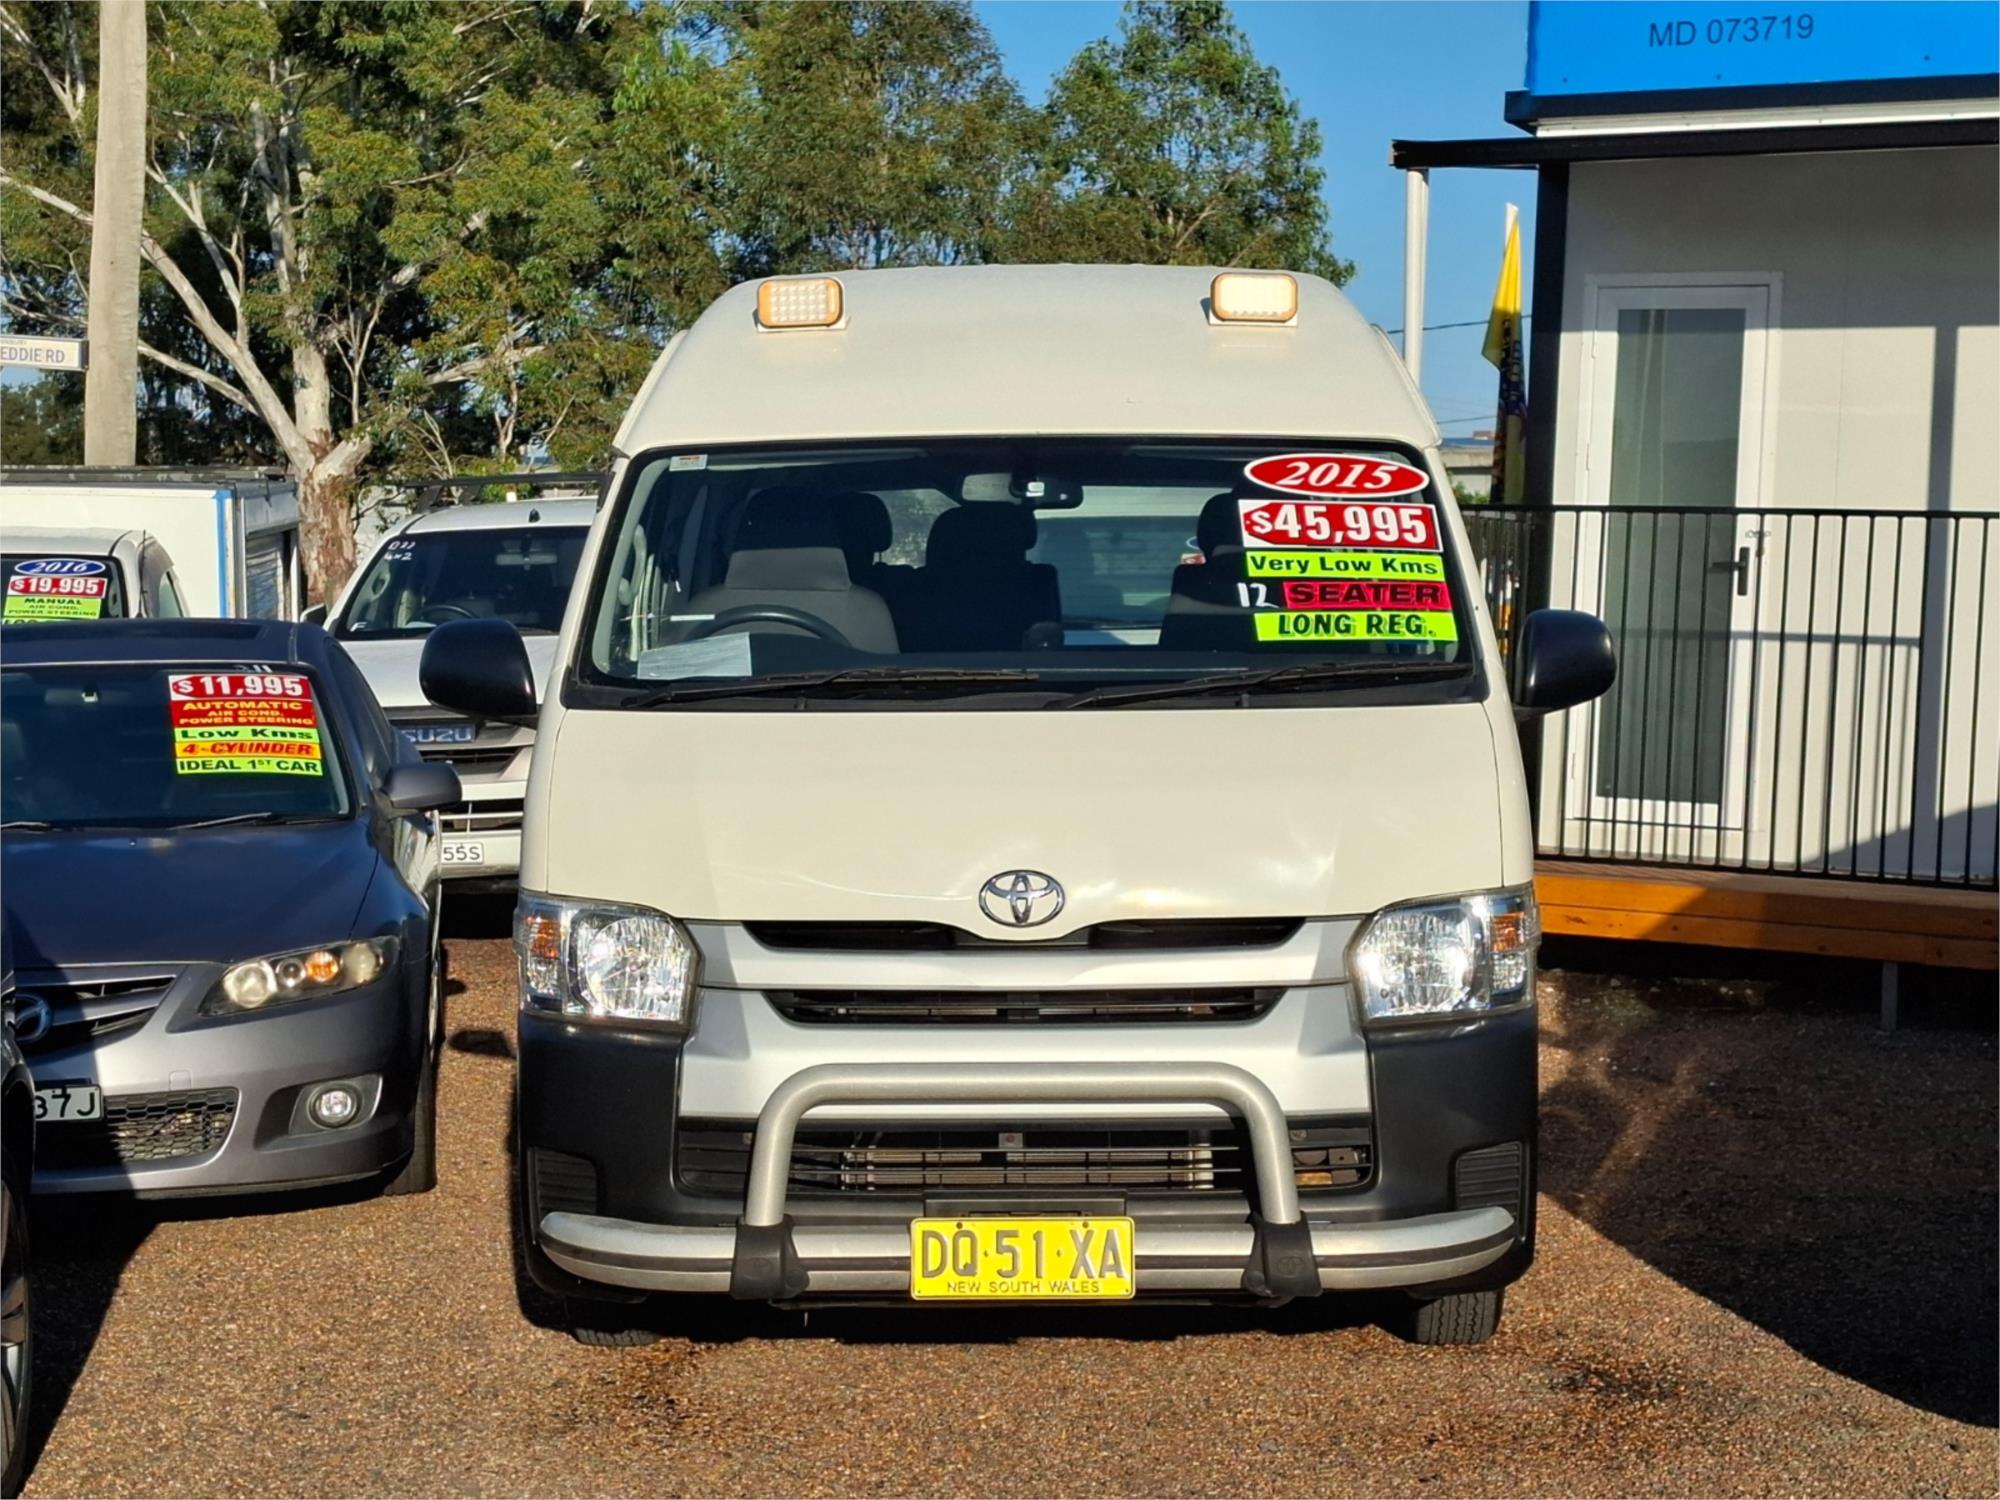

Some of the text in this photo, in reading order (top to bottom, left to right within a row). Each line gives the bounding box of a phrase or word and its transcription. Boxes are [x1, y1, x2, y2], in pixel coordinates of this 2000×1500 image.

[1649, 13, 1815, 48] MD 073719
[0, 345, 66, 363] EDDIE RD
[1275, 461, 1400, 490] 2015
[1250, 503, 1428, 544] $45,995
[29, 561, 89, 573] 2016
[1250, 555, 1439, 575] Very Low Kms
[13, 577, 100, 595] $19,995
[24, 597, 83, 606] MANUAL
[1236, 582, 1441, 608] 12 SEATER
[1278, 613, 1436, 637] LONG REG.
[177, 675, 303, 696] $11,995
[183, 701, 303, 711] AUTOMATIC
[179, 716, 313, 725] POWER STEERING
[181, 728, 313, 739] Low Kms
[400, 727, 473, 743] SUZU
[183, 742, 313, 755] 4-CYLINDER
[180, 759, 242, 771] IDEAL
[276, 760, 319, 773] CAR
[947, 1281, 1100, 1293] NEW SOUTH WALES
